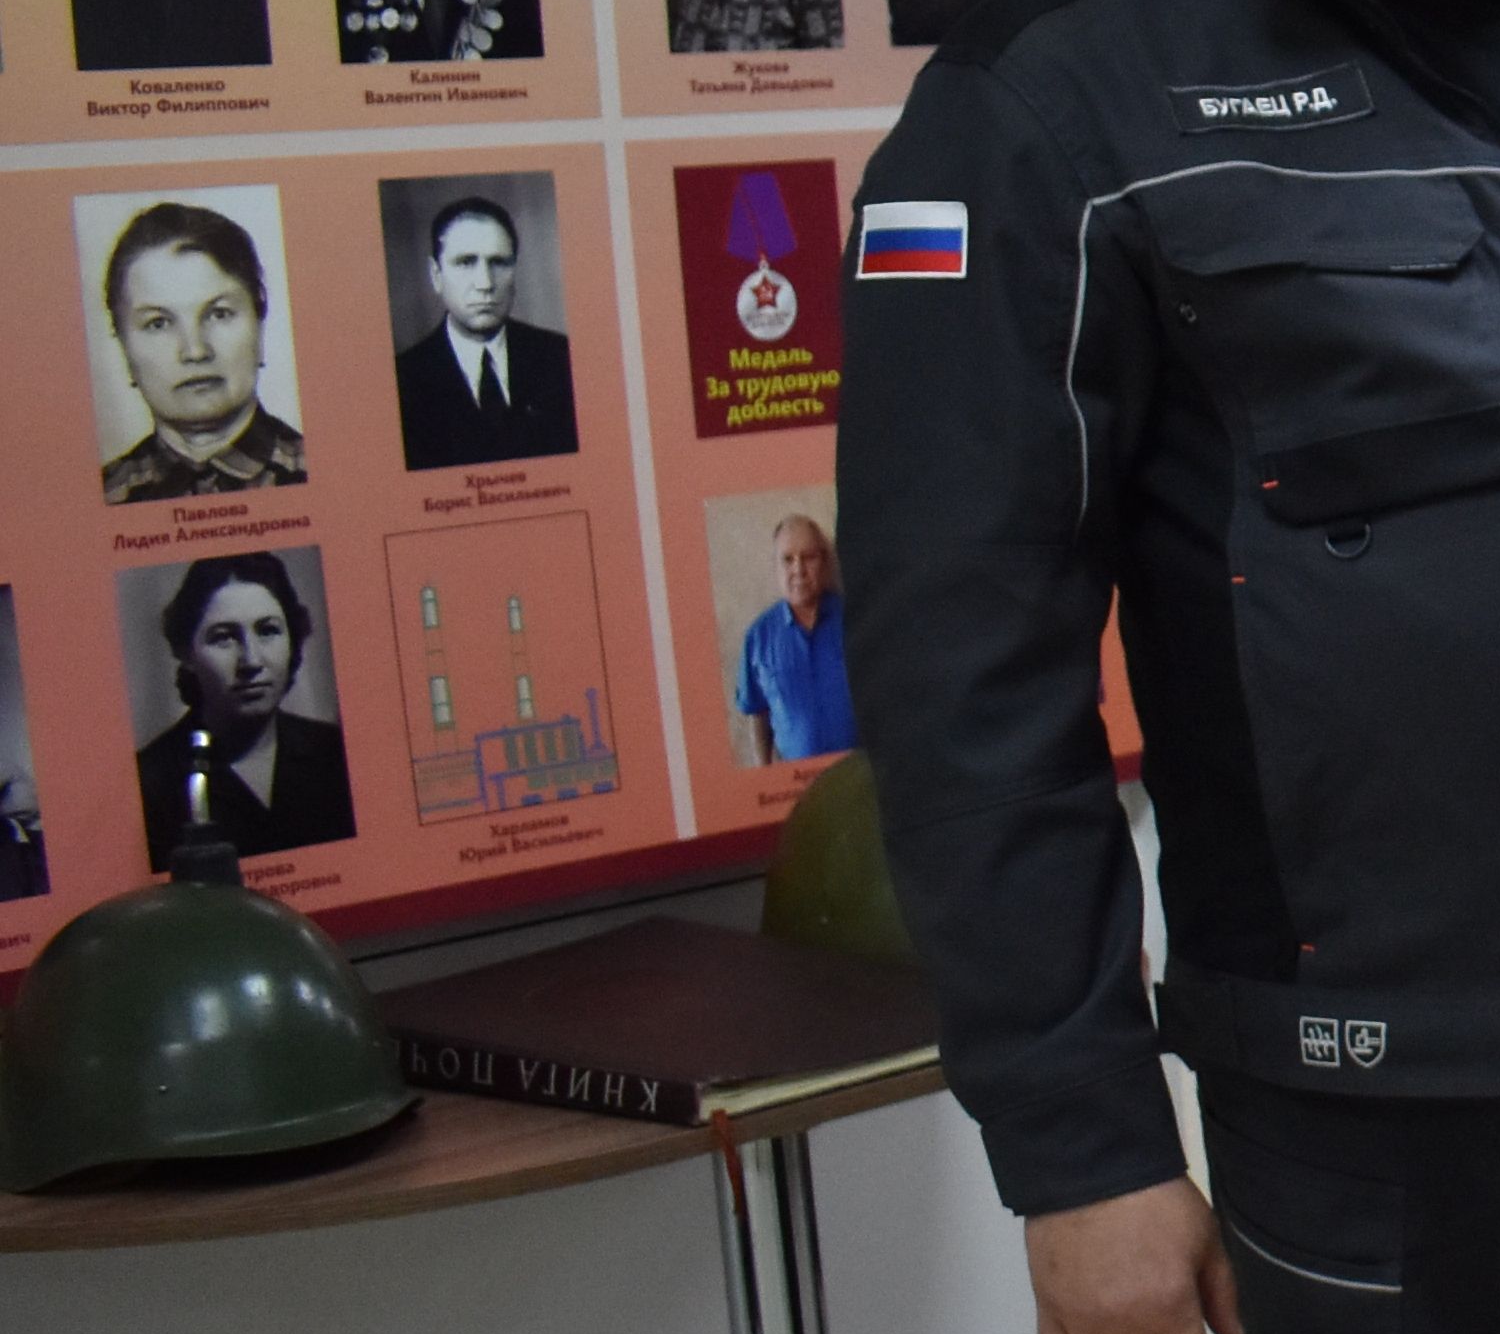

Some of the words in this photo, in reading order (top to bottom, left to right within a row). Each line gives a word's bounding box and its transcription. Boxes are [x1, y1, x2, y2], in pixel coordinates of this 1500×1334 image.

[410, 69, 481, 85] Калинин
[733, 61, 790, 77] Жукова
[130, 78, 226, 96] Коваленко
[365, 88, 443, 106] Валентин
[446, 86, 528, 103] Иванович
[689, 79, 746, 95] Татьяна
[750, 77, 834, 94] Давыдовна
[87, 99, 151, 118] Виктор
[156, 96, 270, 115] Филиппович
[1199, 94, 1292, 117] БУГАЕЦ
[1292, 86, 1338, 113] Р.Д.
[729, 347, 813, 371] Медаль
[706, 378, 730, 399] За
[737, 368, 840, 399] трудовую
[727, 396, 824, 426] доблесть
[424, 495, 473, 513] Борис
[477, 486, 571, 506] Васильевич
[173, 504, 248, 523] Павлова
[114, 533, 170, 552] Лидия
[175, 514, 311, 543] Александровна
[459, 843, 507, 861] Юрий
[511, 828, 604, 852] Васильевич
[246, 863, 295, 883] трова
[405, 1039, 493, 1086] ПОЧ
[518, 1057, 659, 1113] КНИГА
